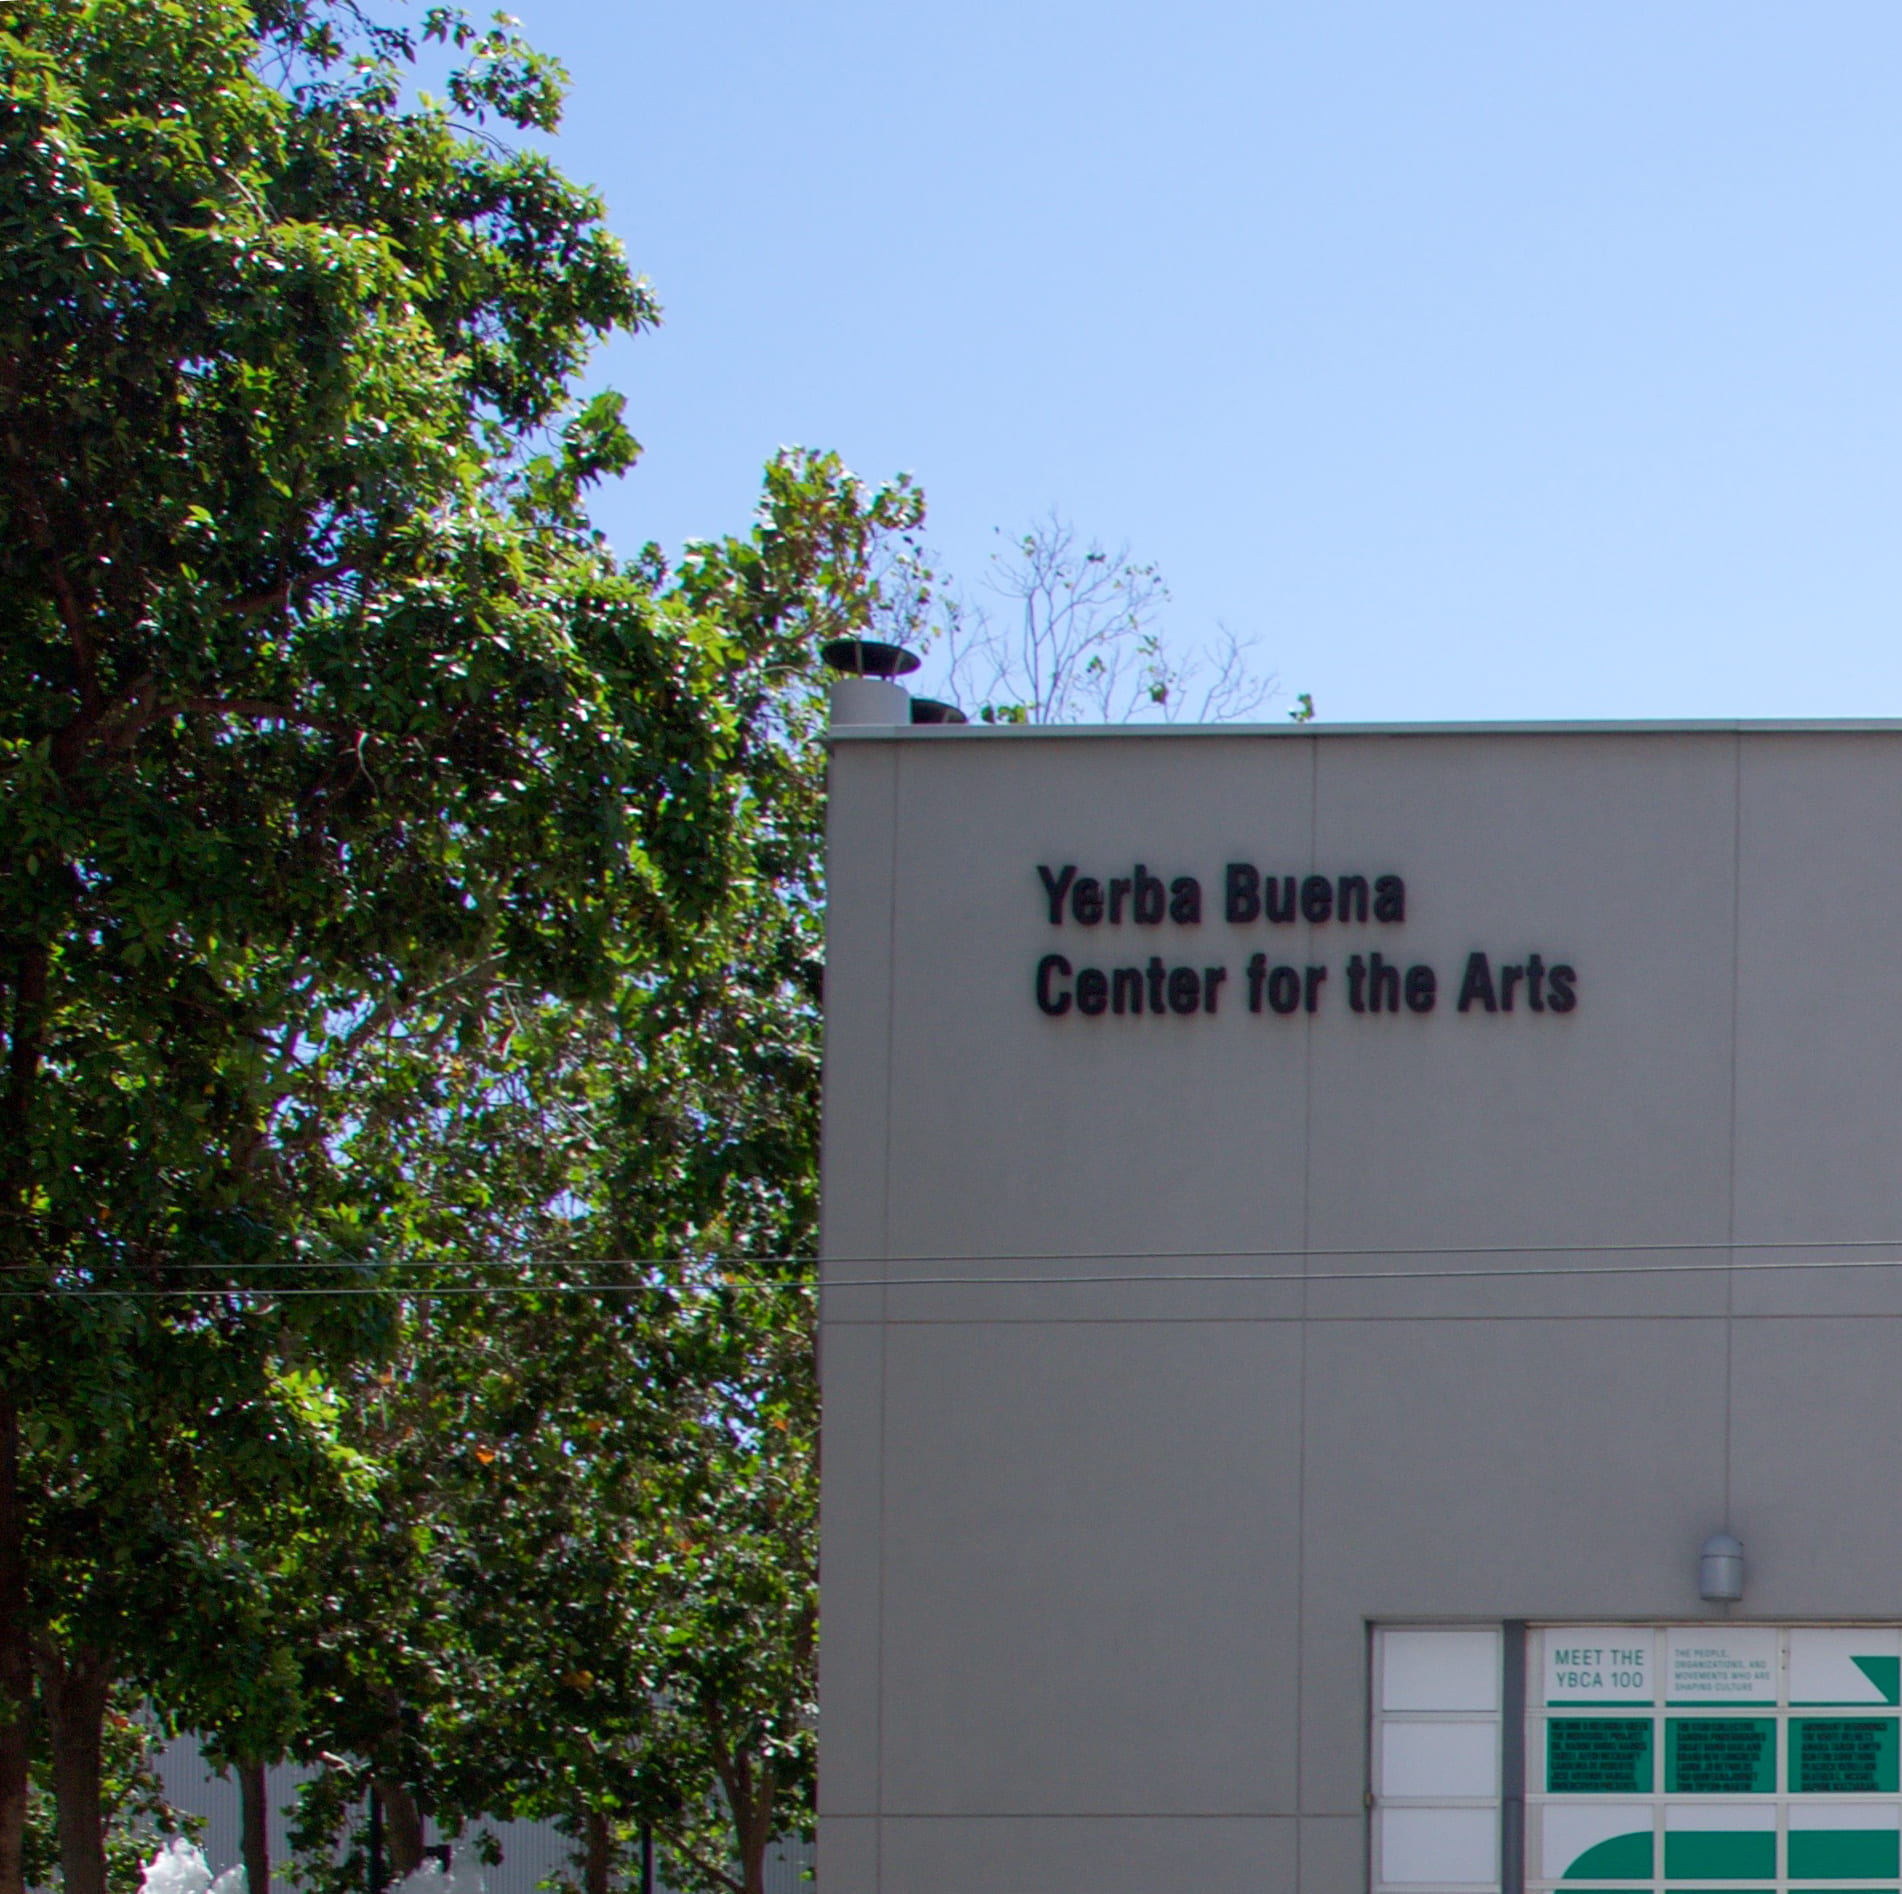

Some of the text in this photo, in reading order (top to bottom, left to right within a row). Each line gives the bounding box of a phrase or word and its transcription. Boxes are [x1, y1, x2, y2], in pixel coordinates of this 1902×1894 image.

[1037, 864, 1406, 927] Yerba Buena
[1035, 952, 1578, 1016] Center for the Arts
[1555, 1649, 1644, 1666] MEET THE
[1674, 1649, 1690, 1657] THE
[1556, 1672, 1644, 1688] YBCA 100
